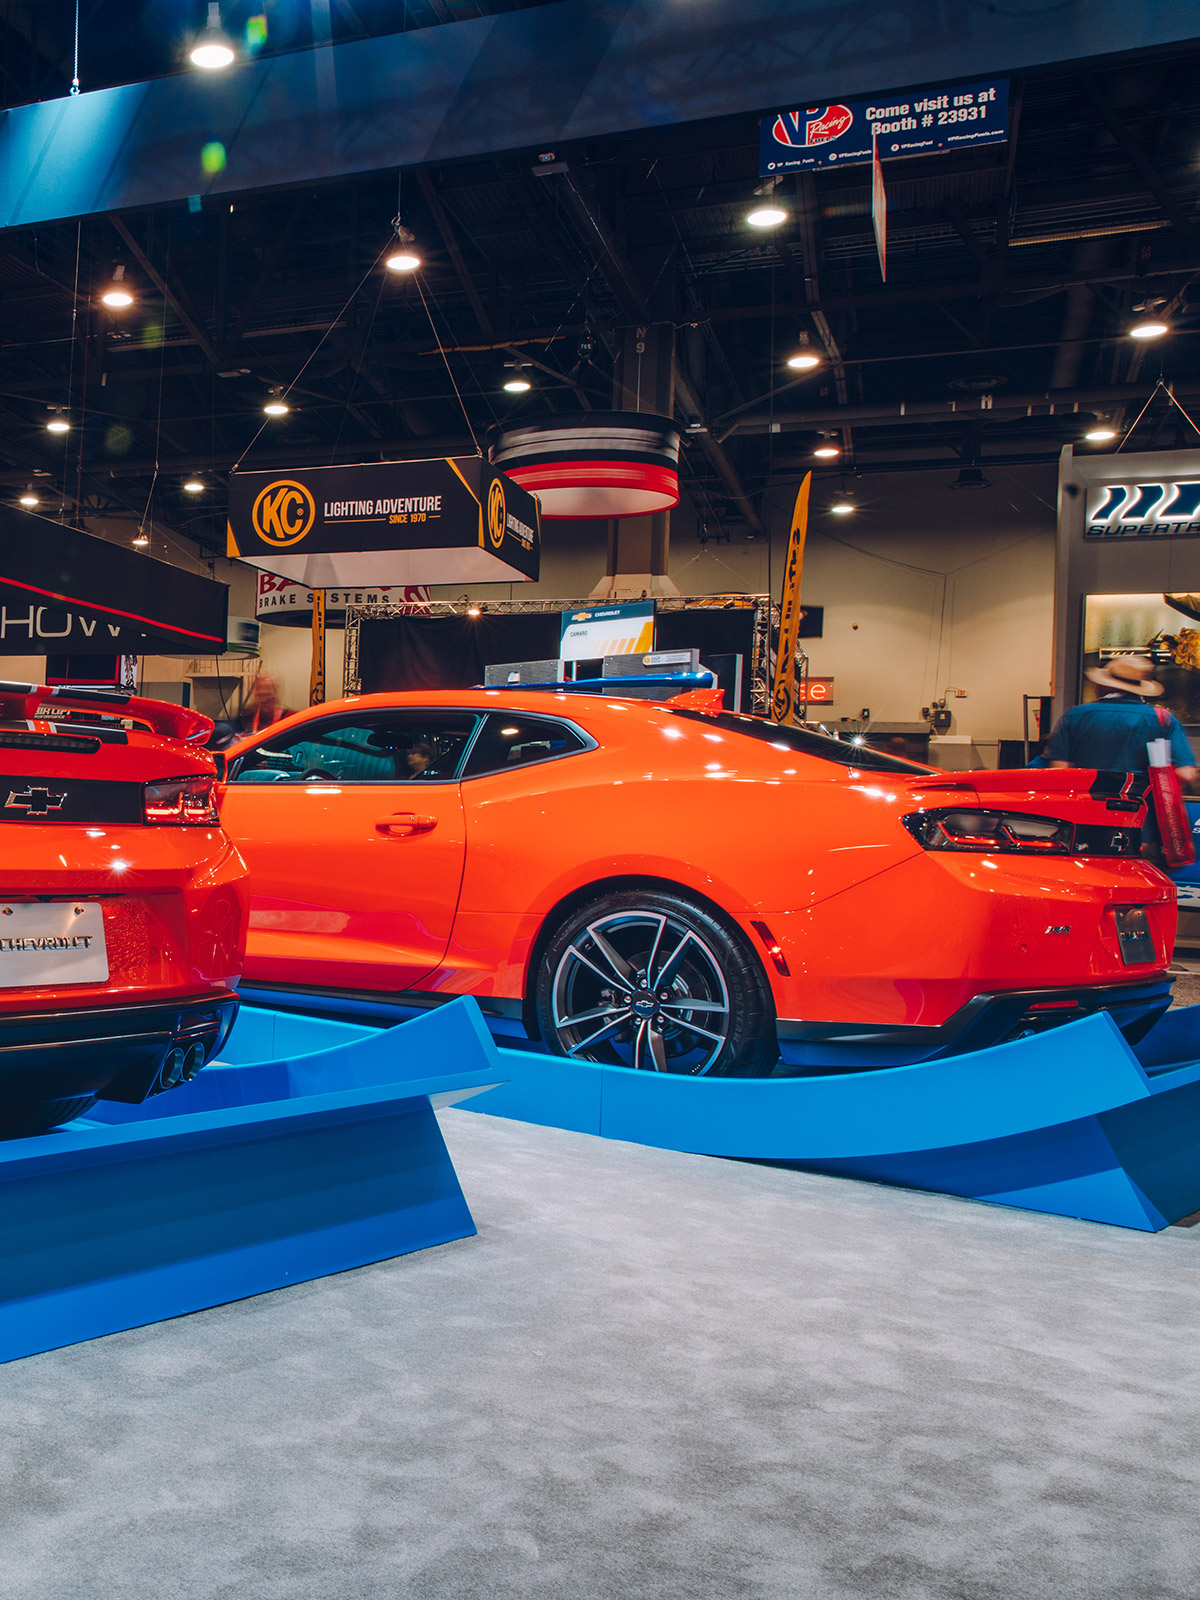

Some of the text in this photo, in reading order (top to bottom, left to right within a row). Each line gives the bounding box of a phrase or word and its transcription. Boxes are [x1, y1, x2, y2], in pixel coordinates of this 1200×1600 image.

[865, 87, 997, 120] Come visit us at
[809, 114, 851, 139] Racing
[871, 105, 988, 135] Booth # 23931
[262, 487, 304, 539] KC
[324, 495, 442, 518] LIGHTING ADVENTURE
[388, 512, 427, 525] SINCE 1970
[259, 592, 390, 609] BRAKE SSTEMS
[594, 609, 621, 618] CHEVROLET
[570, 630, 588, 638] CAMARO
